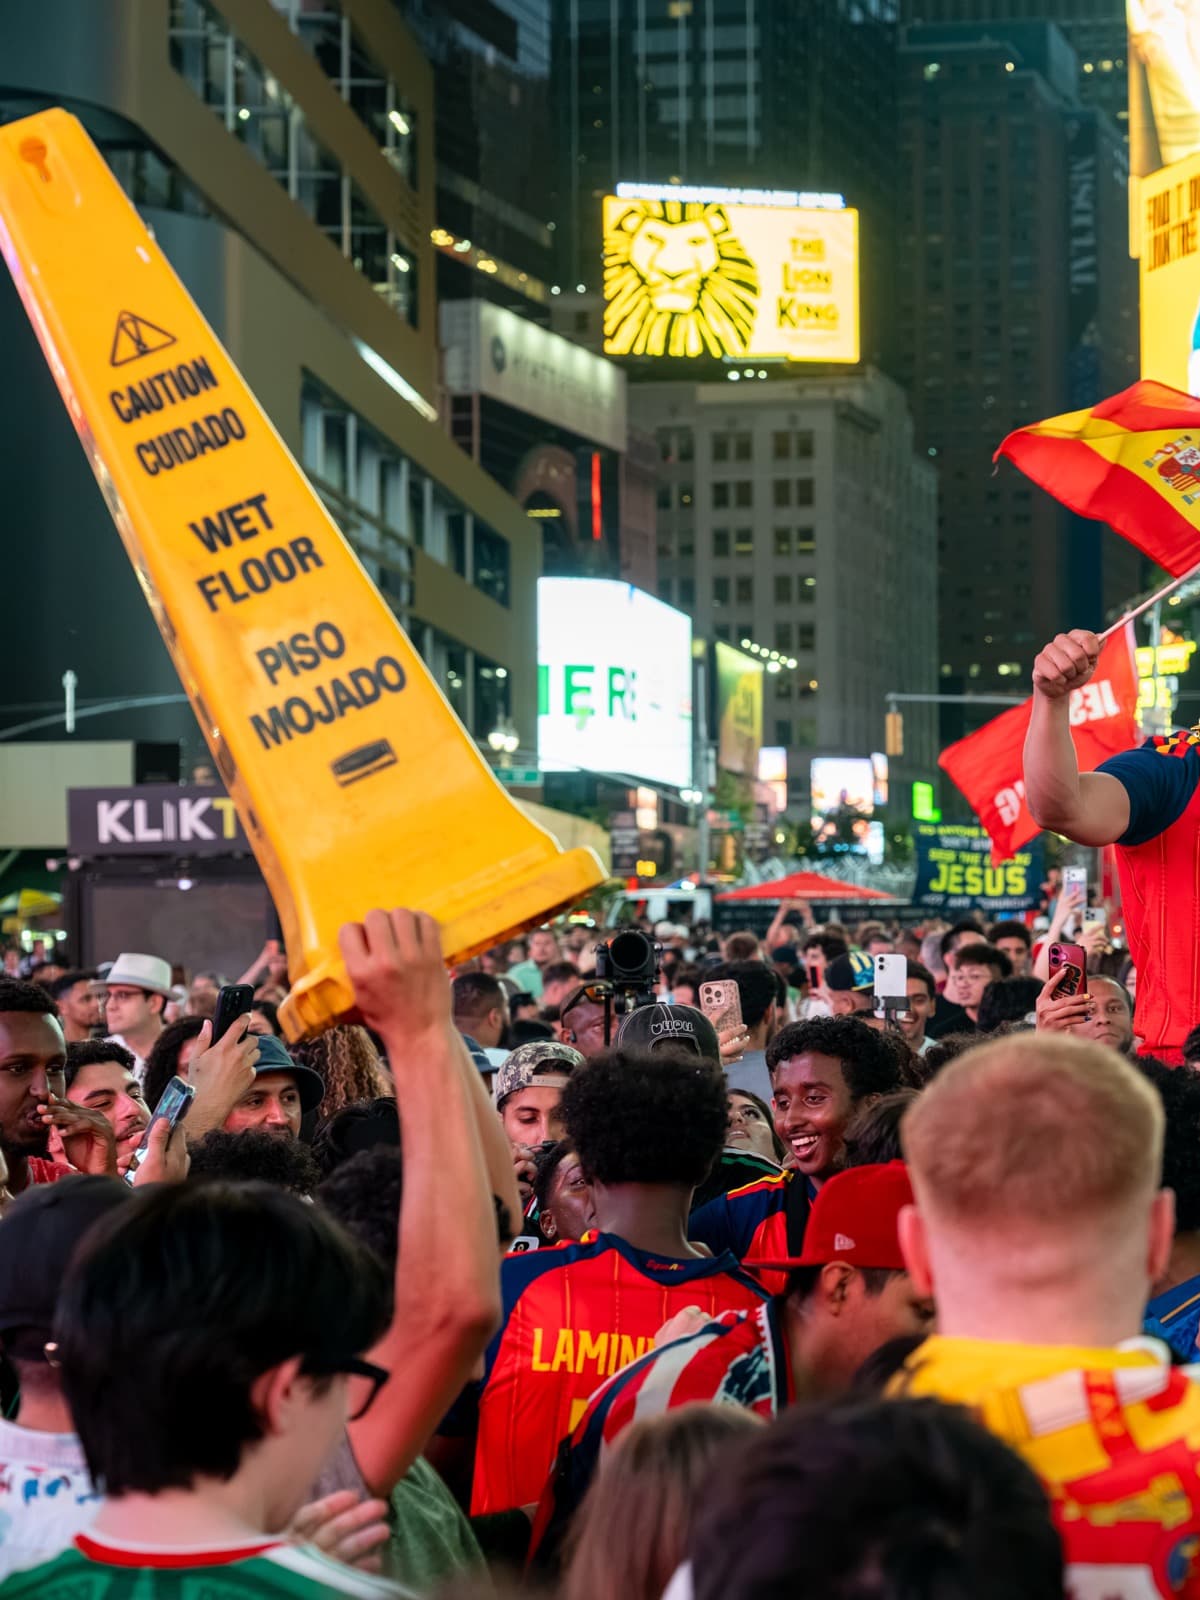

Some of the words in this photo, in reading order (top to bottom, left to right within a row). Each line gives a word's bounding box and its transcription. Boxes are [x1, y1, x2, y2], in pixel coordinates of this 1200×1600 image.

[782, 262, 833, 292] LION
[776, 296, 839, 329] KING
[110, 355, 219, 424] CAUTION
[135, 407, 247, 477] CUIDADO
[188, 493, 274, 554] WET
[196, 536, 325, 613] FLOOR
[255, 621, 346, 686] PISO
[249, 655, 407, 750] MOJADO
[928, 863, 1027, 896] JESUS
[531, 1328, 655, 1376] LAMIN
